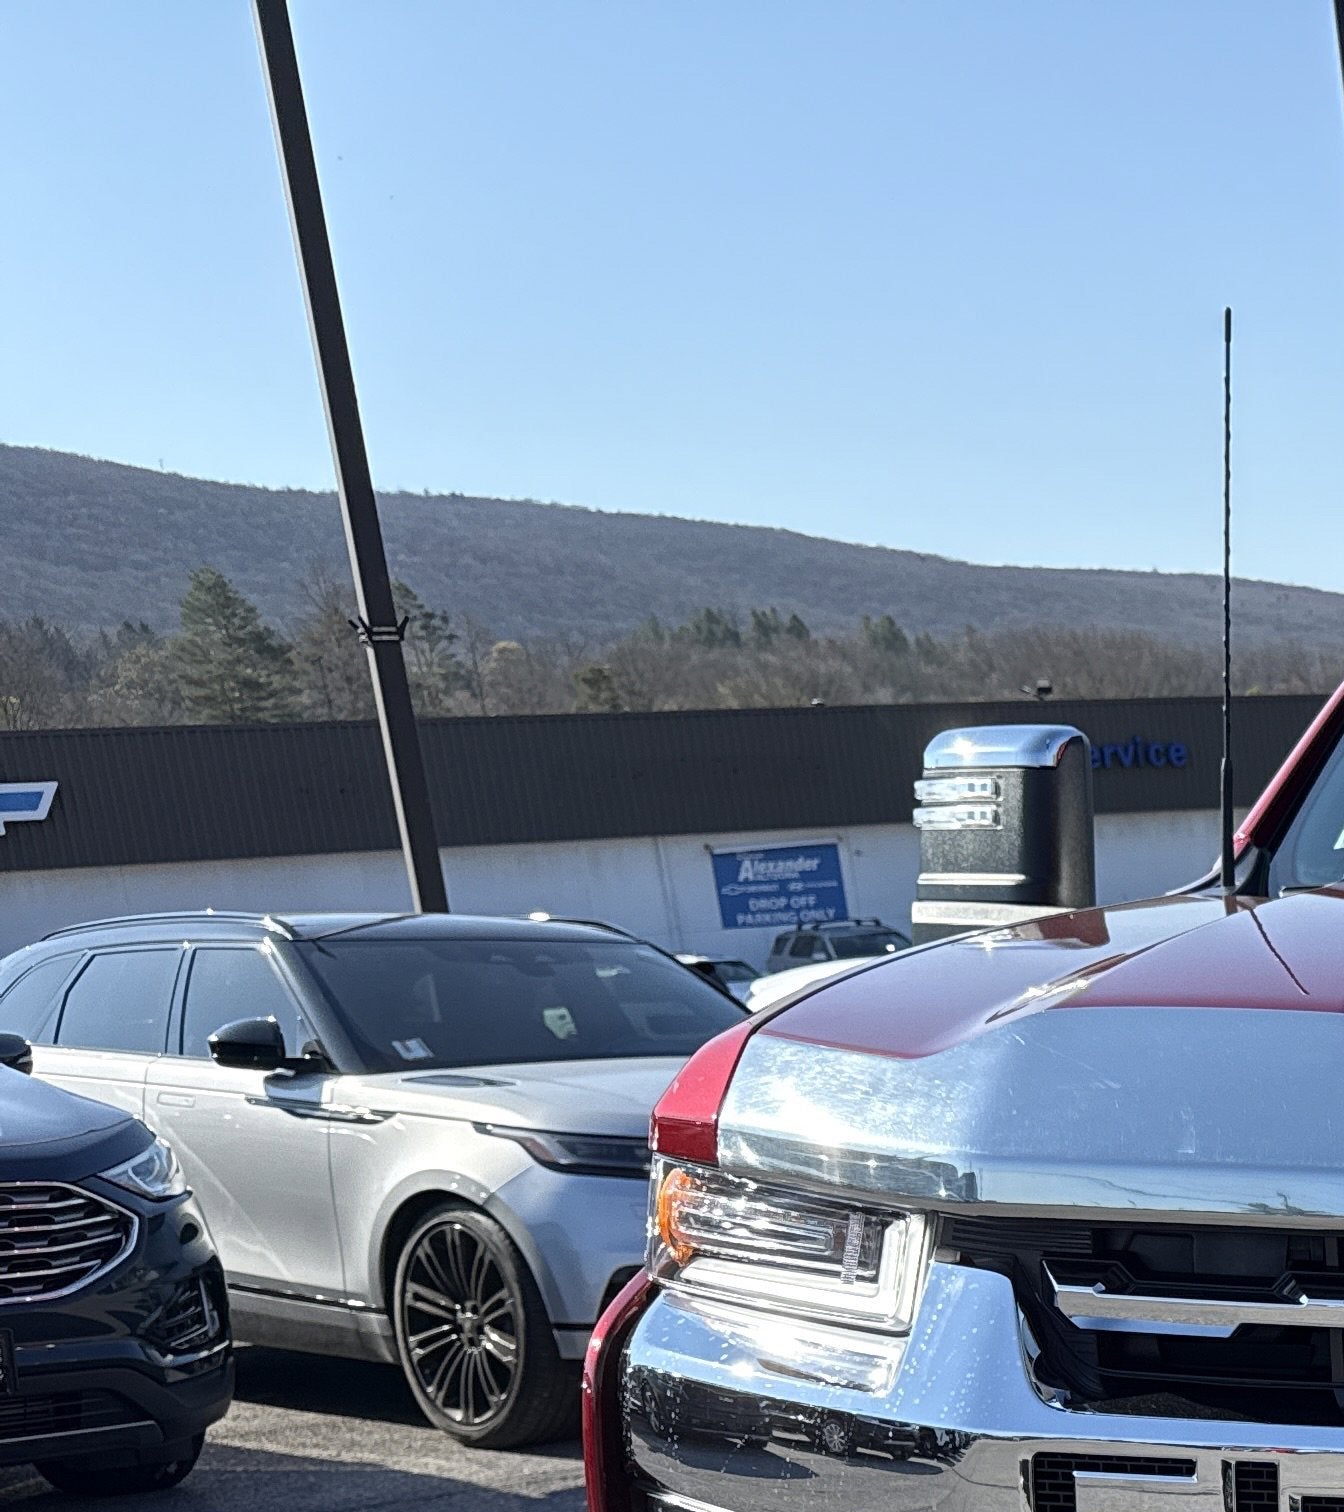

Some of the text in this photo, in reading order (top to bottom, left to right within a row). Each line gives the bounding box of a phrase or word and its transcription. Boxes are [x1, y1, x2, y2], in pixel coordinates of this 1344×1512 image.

[1090, 736, 1187, 768] ervice
[738, 856, 820, 882] Alexander
[749, 894, 817, 912] DROP OFF
[736, 907, 836, 926] PARKING ONLY
